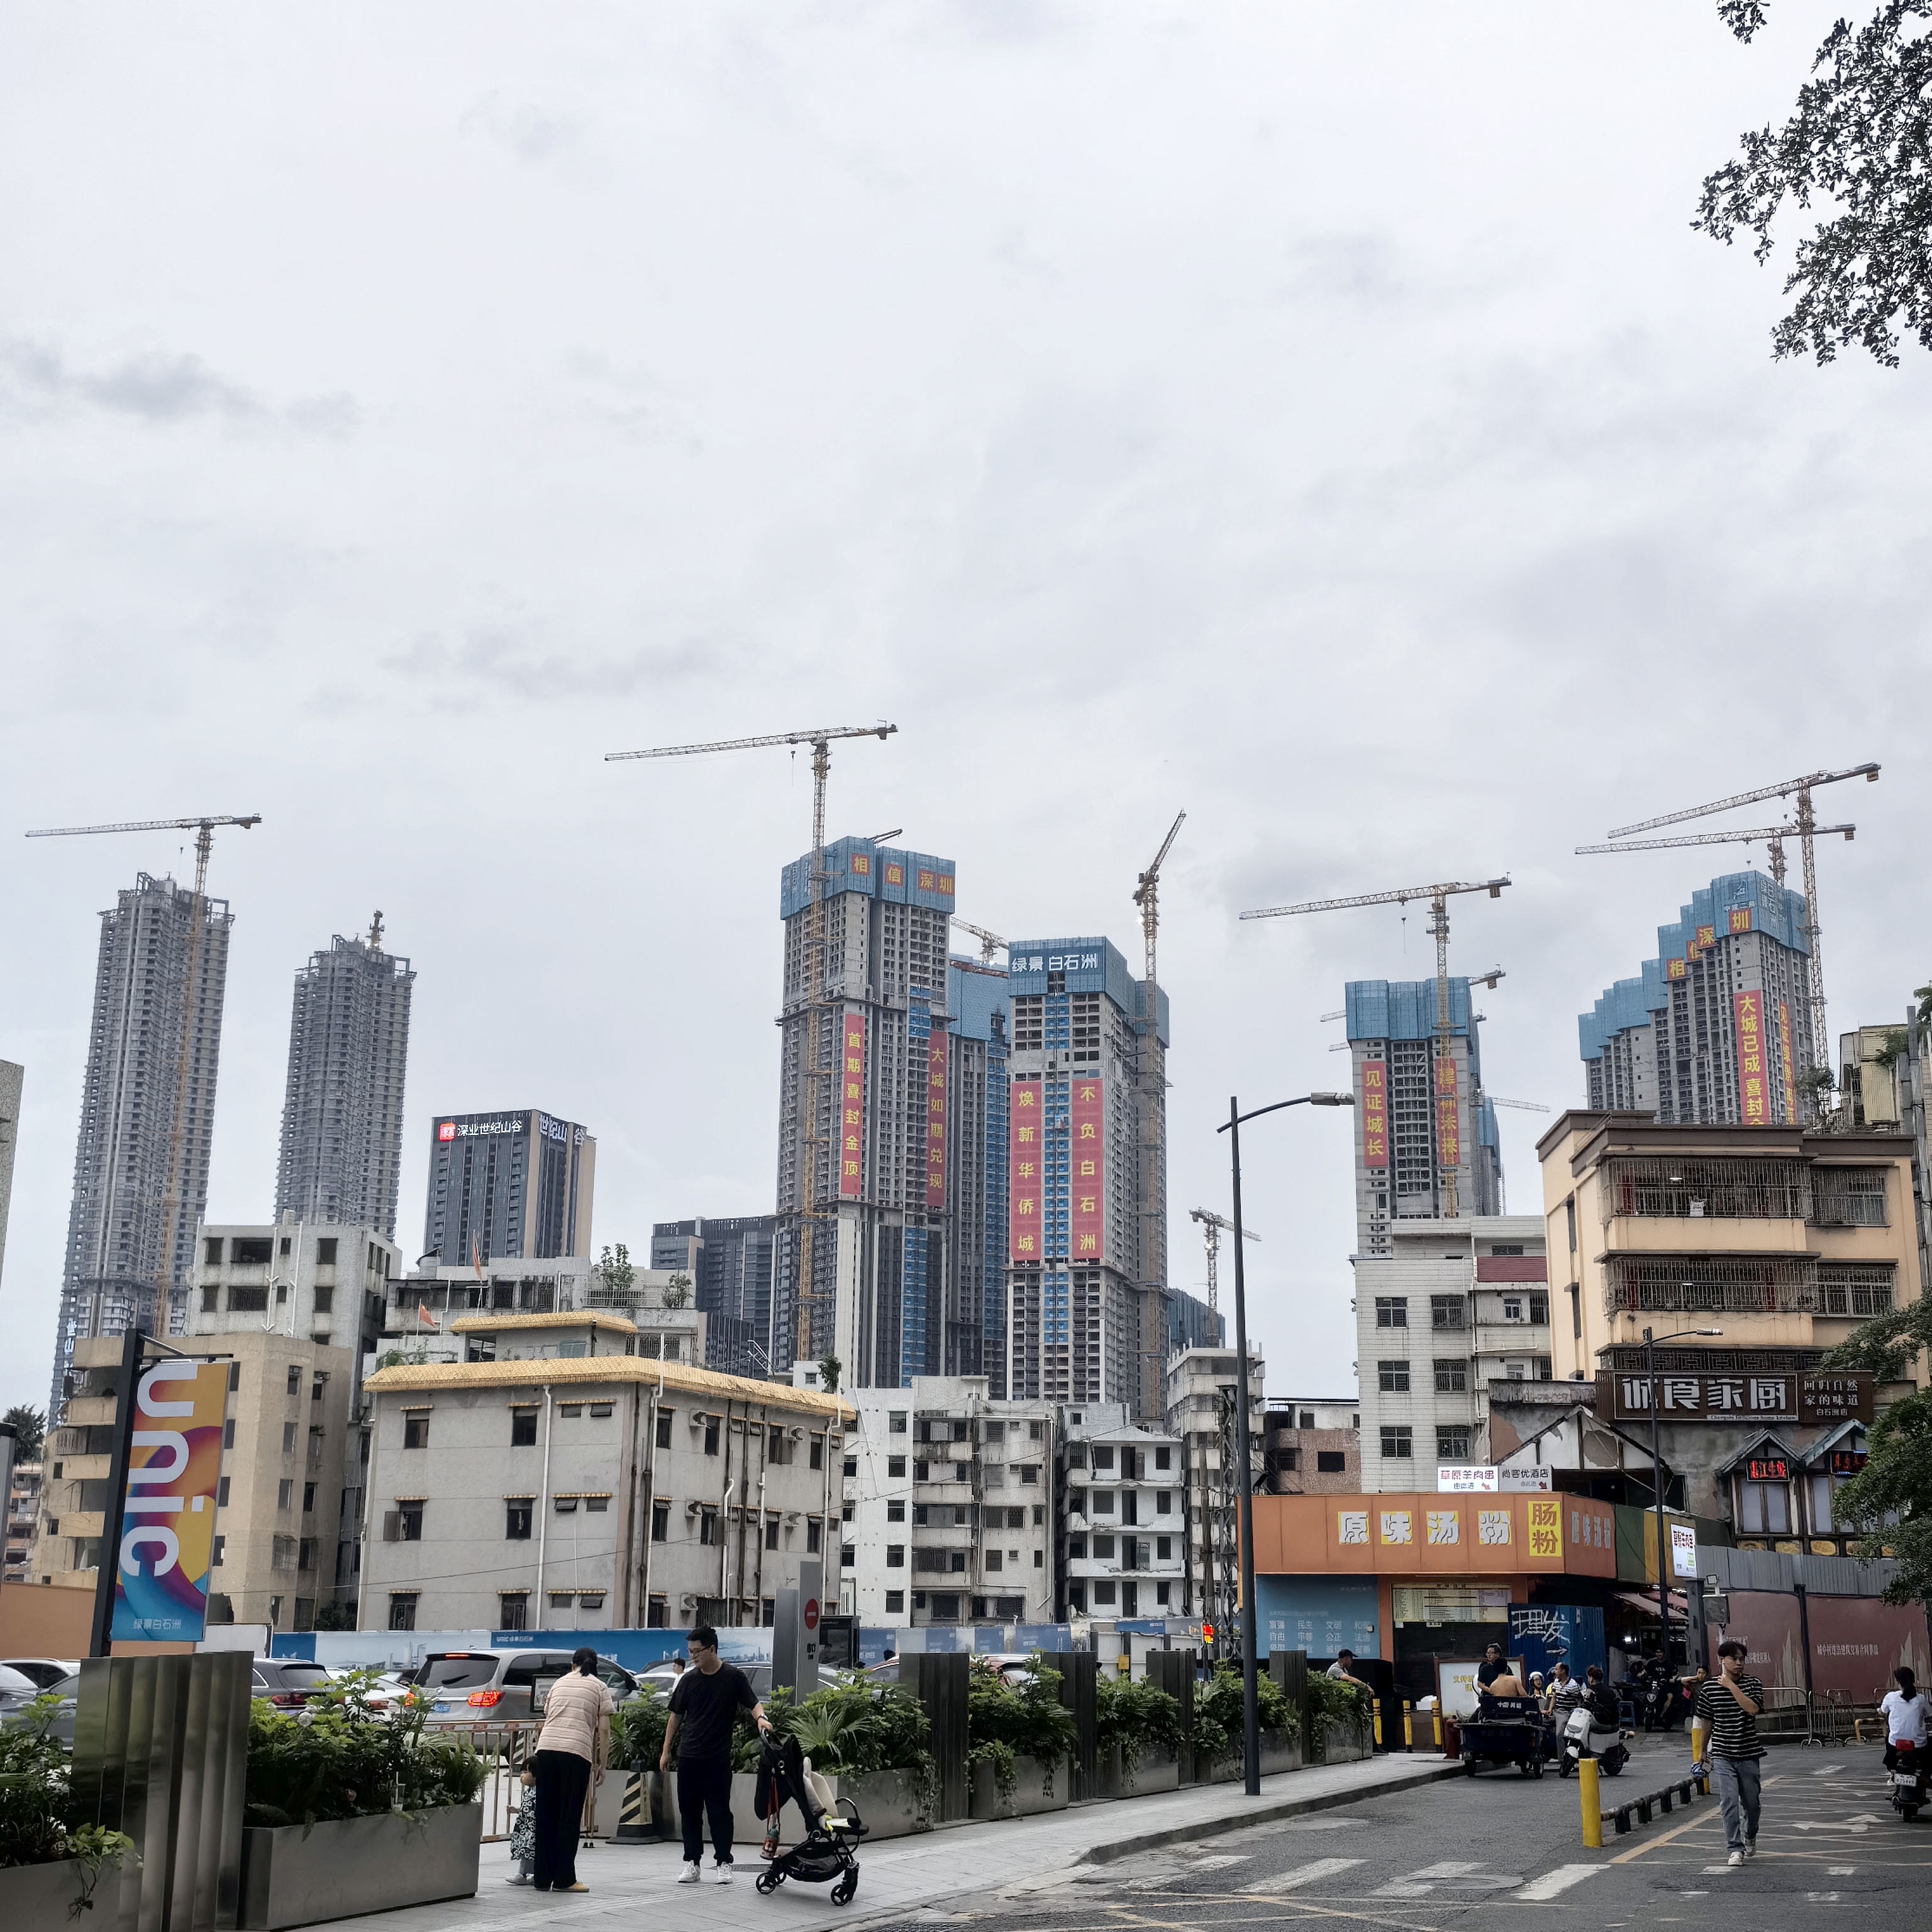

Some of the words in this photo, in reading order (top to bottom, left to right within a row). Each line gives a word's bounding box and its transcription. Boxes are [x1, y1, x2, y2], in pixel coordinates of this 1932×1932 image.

[854, 857, 952, 894] 相信深圳
[1011, 956, 1044, 972] 绿景
[1048, 953, 1098, 972] 白石洲
[844, 1032, 862, 1176] 首期喜封金顶
[929, 1047, 944, 1188] 大城如期兑现
[1365, 1070, 1384, 1156] 见证城长
[457, 1119, 523, 1137] 深业世纪山谷
[1018, 1090, 1035, 1252] 焕新华侨城
[1080, 1086, 1096, 1251] 不负白石洲
[1804, 1379, 1859, 1392] 回归自然
[1804, 1394, 1859, 1406] 家的味道
[119, 1363, 204, 1577] unic
[1338, 1511, 1511, 1545] 原味汤粉
[1531, 1503, 1558, 1555] 肠粉
[133, 1618, 182, 1630] 绿景白石洲
[1297, 1620, 1313, 1629] 民主
[1326, 1632, 1342, 1641] 公正
[1511, 1608, 1571, 1643] 理发
